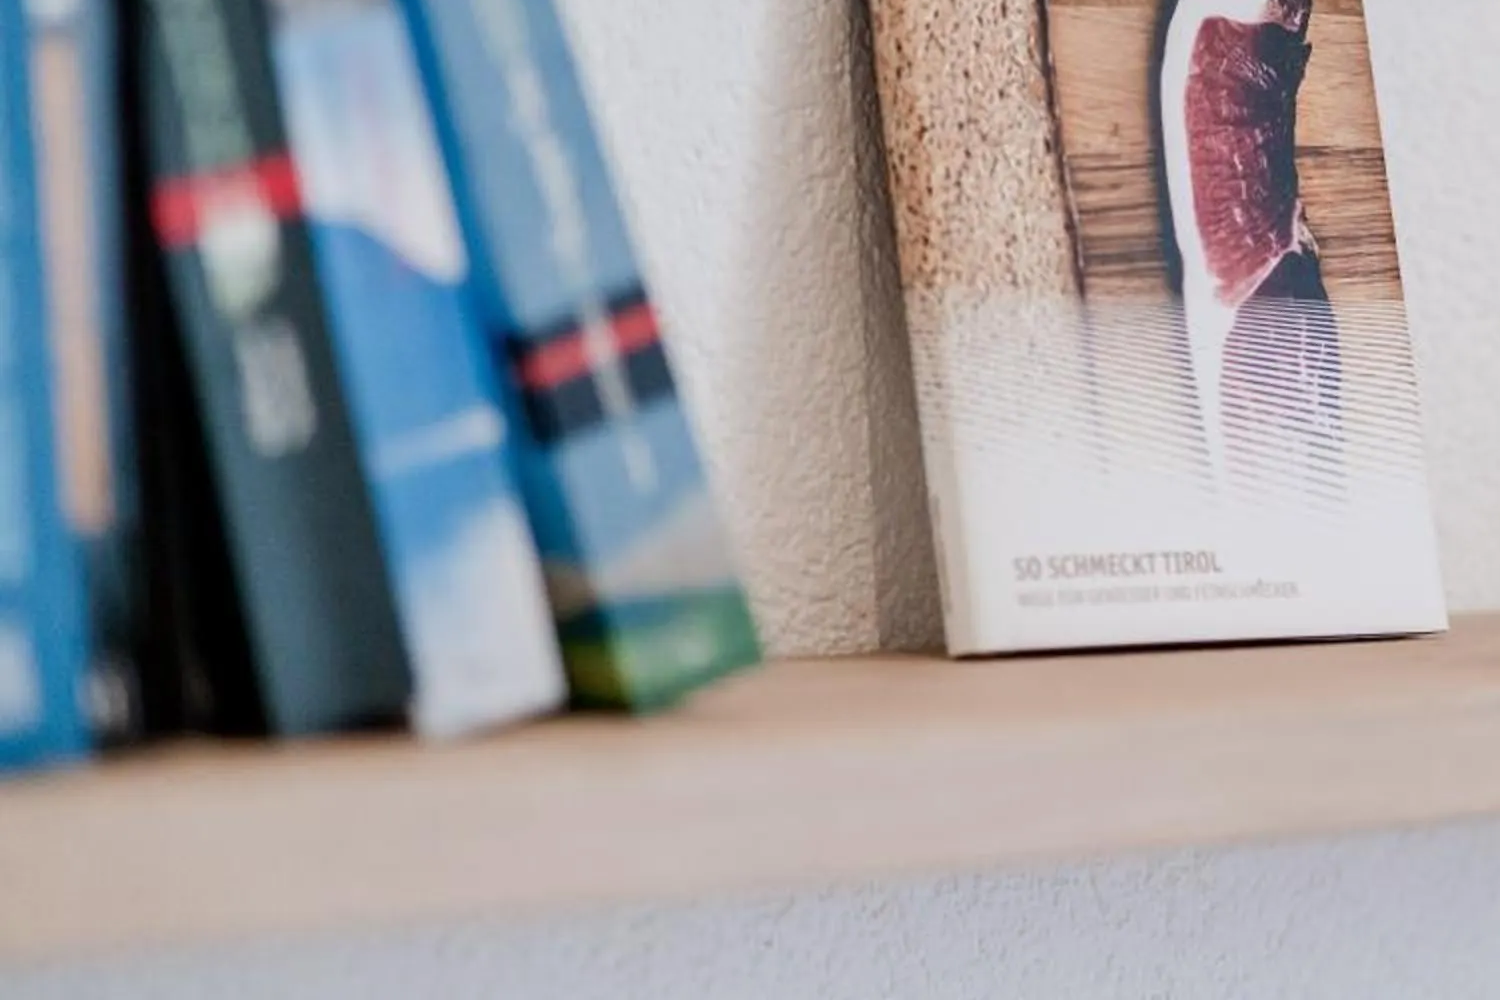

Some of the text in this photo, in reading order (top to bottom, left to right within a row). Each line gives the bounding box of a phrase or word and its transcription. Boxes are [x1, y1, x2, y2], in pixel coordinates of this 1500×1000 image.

[1012, 550, 1224, 582] SO SCHMECKT TIROL
